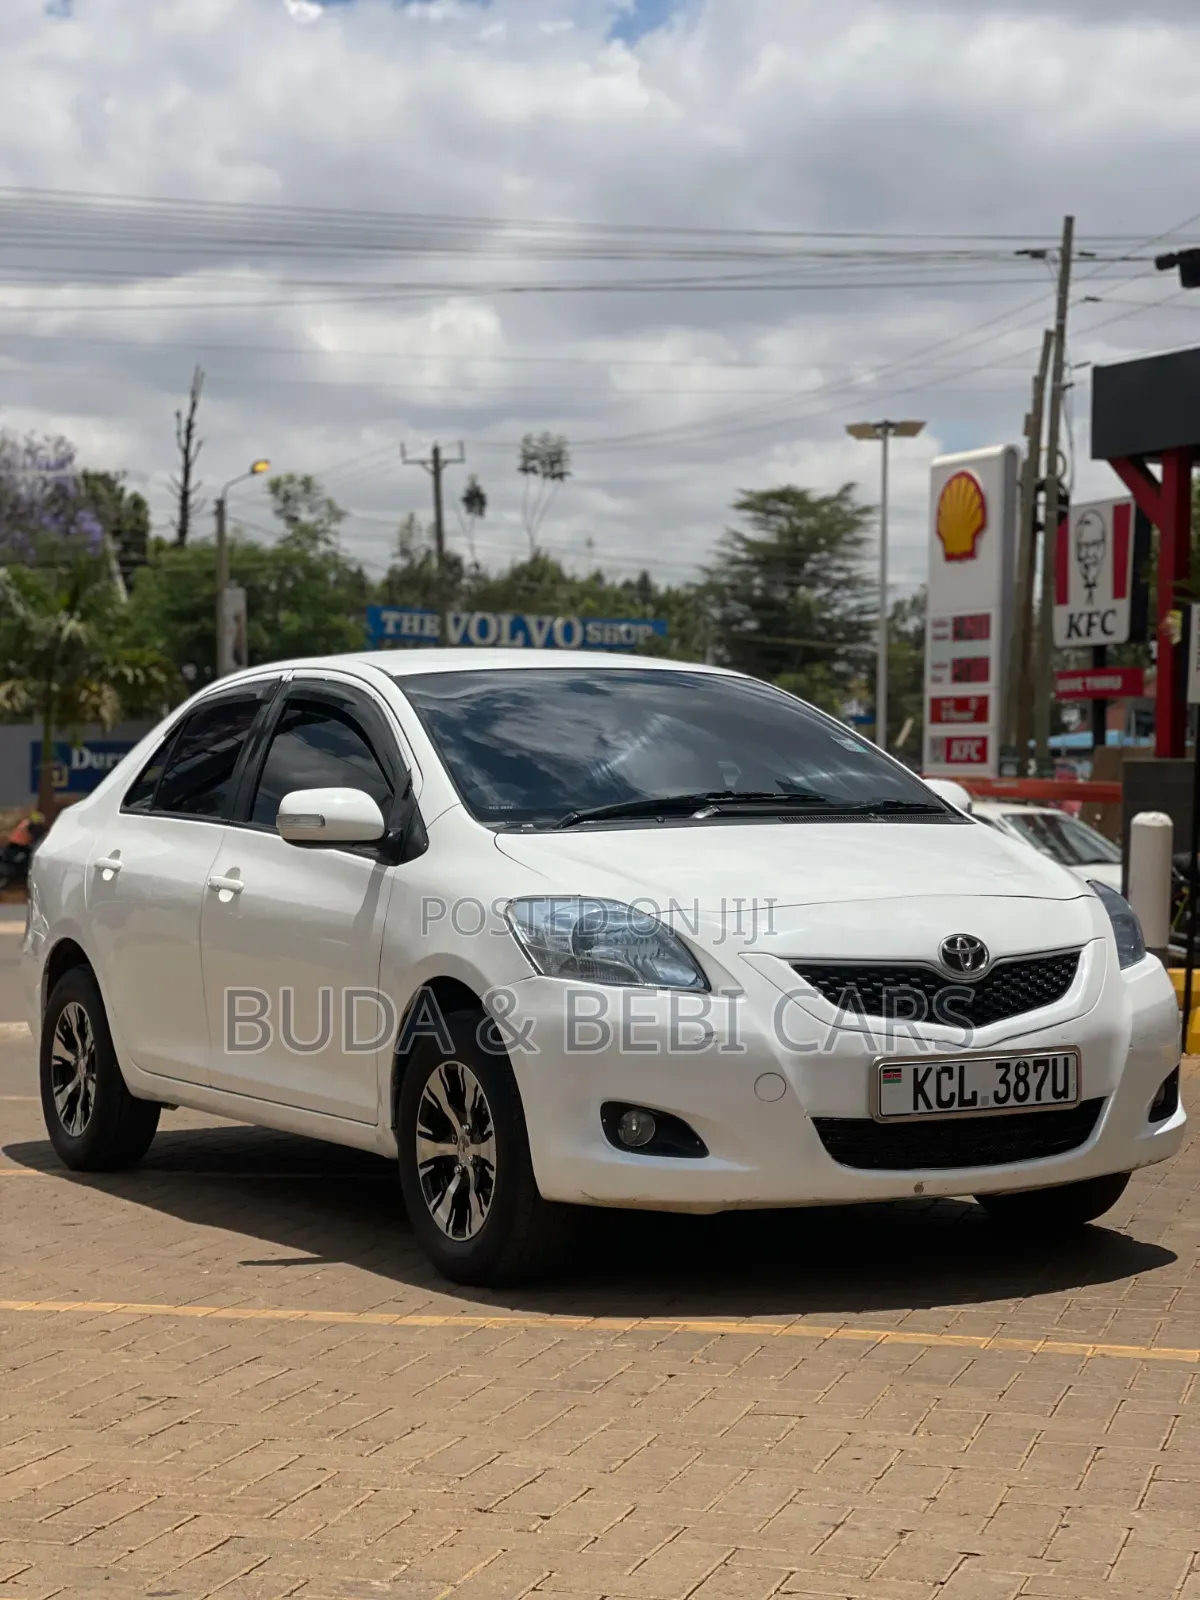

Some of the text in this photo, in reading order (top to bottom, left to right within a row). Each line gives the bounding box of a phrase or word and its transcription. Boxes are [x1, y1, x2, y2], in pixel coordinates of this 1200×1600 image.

[379, 610, 653, 648] THE VOLVO SHOP
[1065, 608, 1117, 639] KFC
[912, 1064, 978, 1111] KCL
[993, 1056, 1070, 1105] 387U
